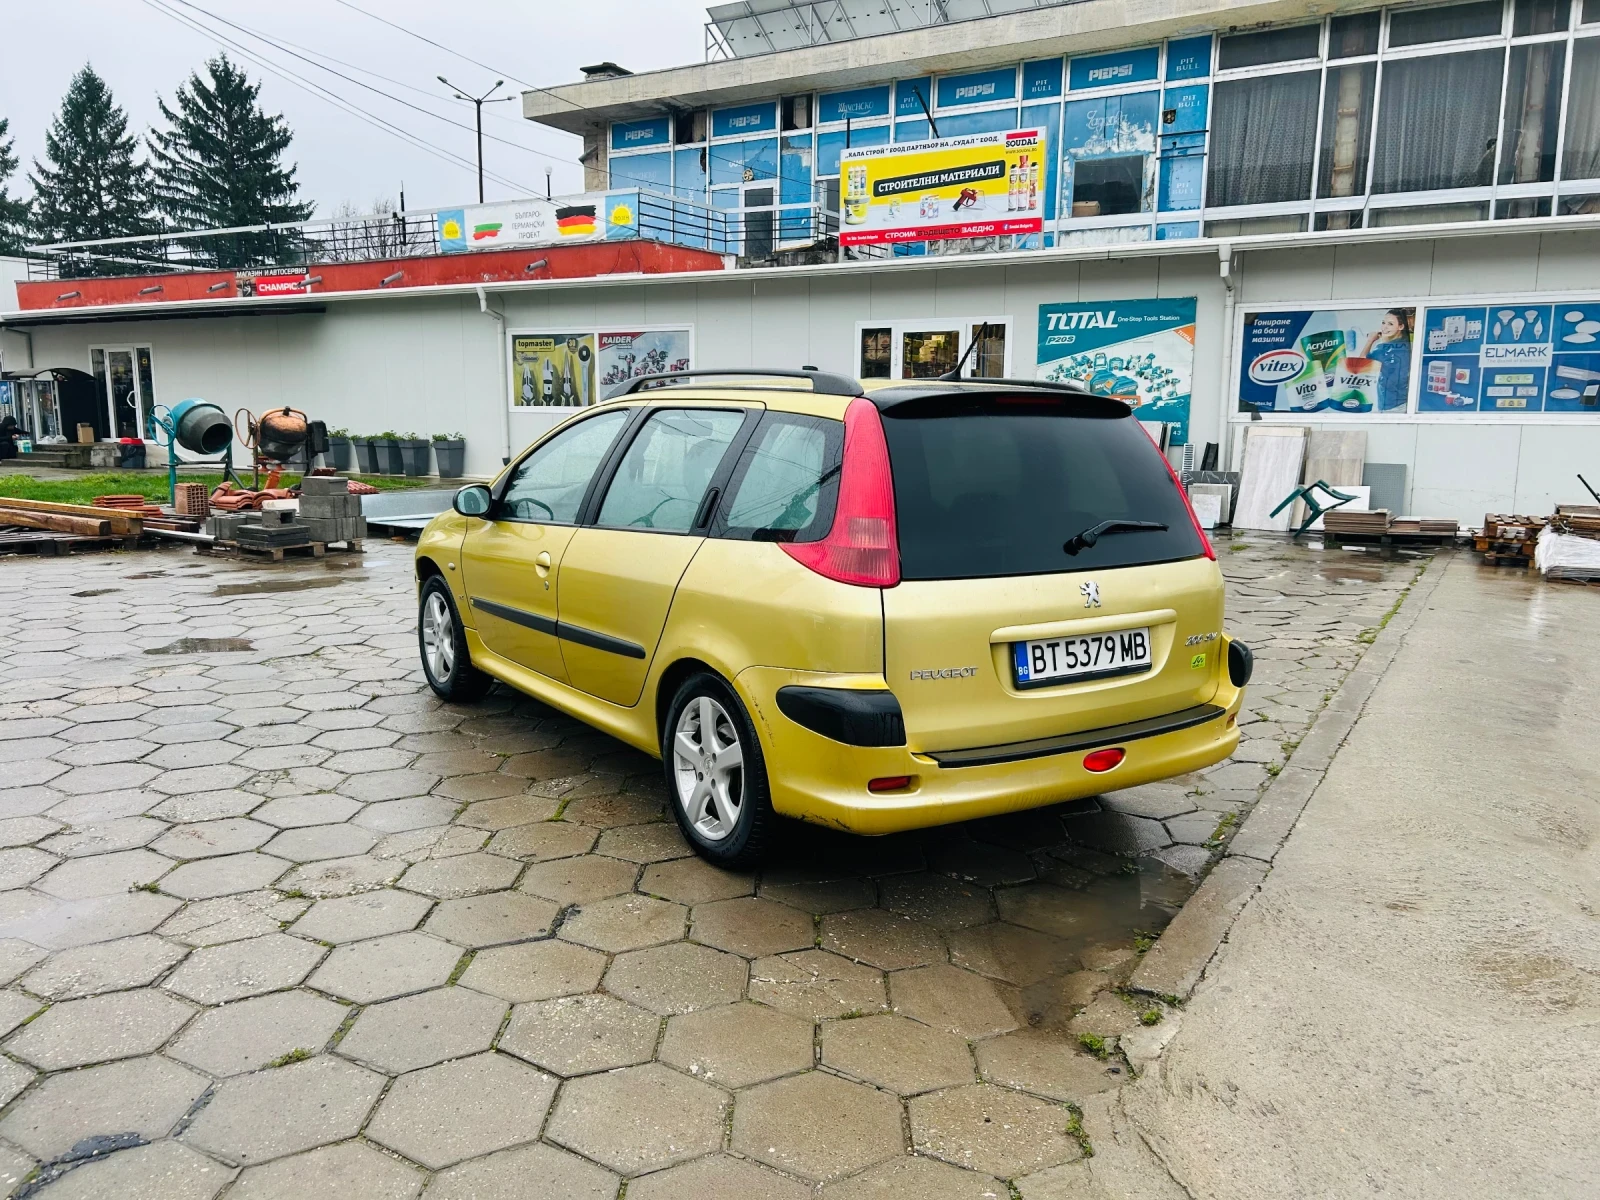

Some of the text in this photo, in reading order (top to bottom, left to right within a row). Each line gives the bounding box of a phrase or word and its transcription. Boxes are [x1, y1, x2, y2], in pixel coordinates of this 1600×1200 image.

[1088, 64, 1133, 81] PEPSI
[1176, 62, 1200, 72] BULL
[955, 83, 996, 99] PEPSI
[1178, 100, 1201, 108] BULL
[1182, 94, 1196, 102] PIT
[729, 114, 761, 127] PEPSI
[625, 128, 653, 140] PEPSI
[1005, 138, 1038, 148] SOUDAL
[878, 165, 1000, 192] СТРОИТЕЛНИ МАТЕРИАЛИ
[512, 221, 544, 230] ГЕРМАНСКИ
[518, 231, 540, 239] ПРОЕКТ
[885, 225, 994, 239] СТРОИМ БЪДЕЩЕТО ЗАЕДНО
[236, 270, 262, 278] МАГАЗИН
[268, 267, 306, 276] АВТОСЕРВИЗ
[1046, 310, 1118, 330] TOTAL
[518, 340, 552, 348] topmaster
[602, 336, 632, 344] RAIDER
[1047, 336, 1074, 345] P20S
[1305, 339, 1339, 351] Acrylan
[1485, 346, 1548, 358] ELMARK
[1259, 359, 1298, 372] vitex
[1340, 374, 1373, 387] vitex
[1296, 383, 1317, 395] Vito
[1031, 632, 1147, 674] BT 5379 MB
[910, 666, 979, 680] PEUGEOT
[1018, 665, 1028, 676] BG
